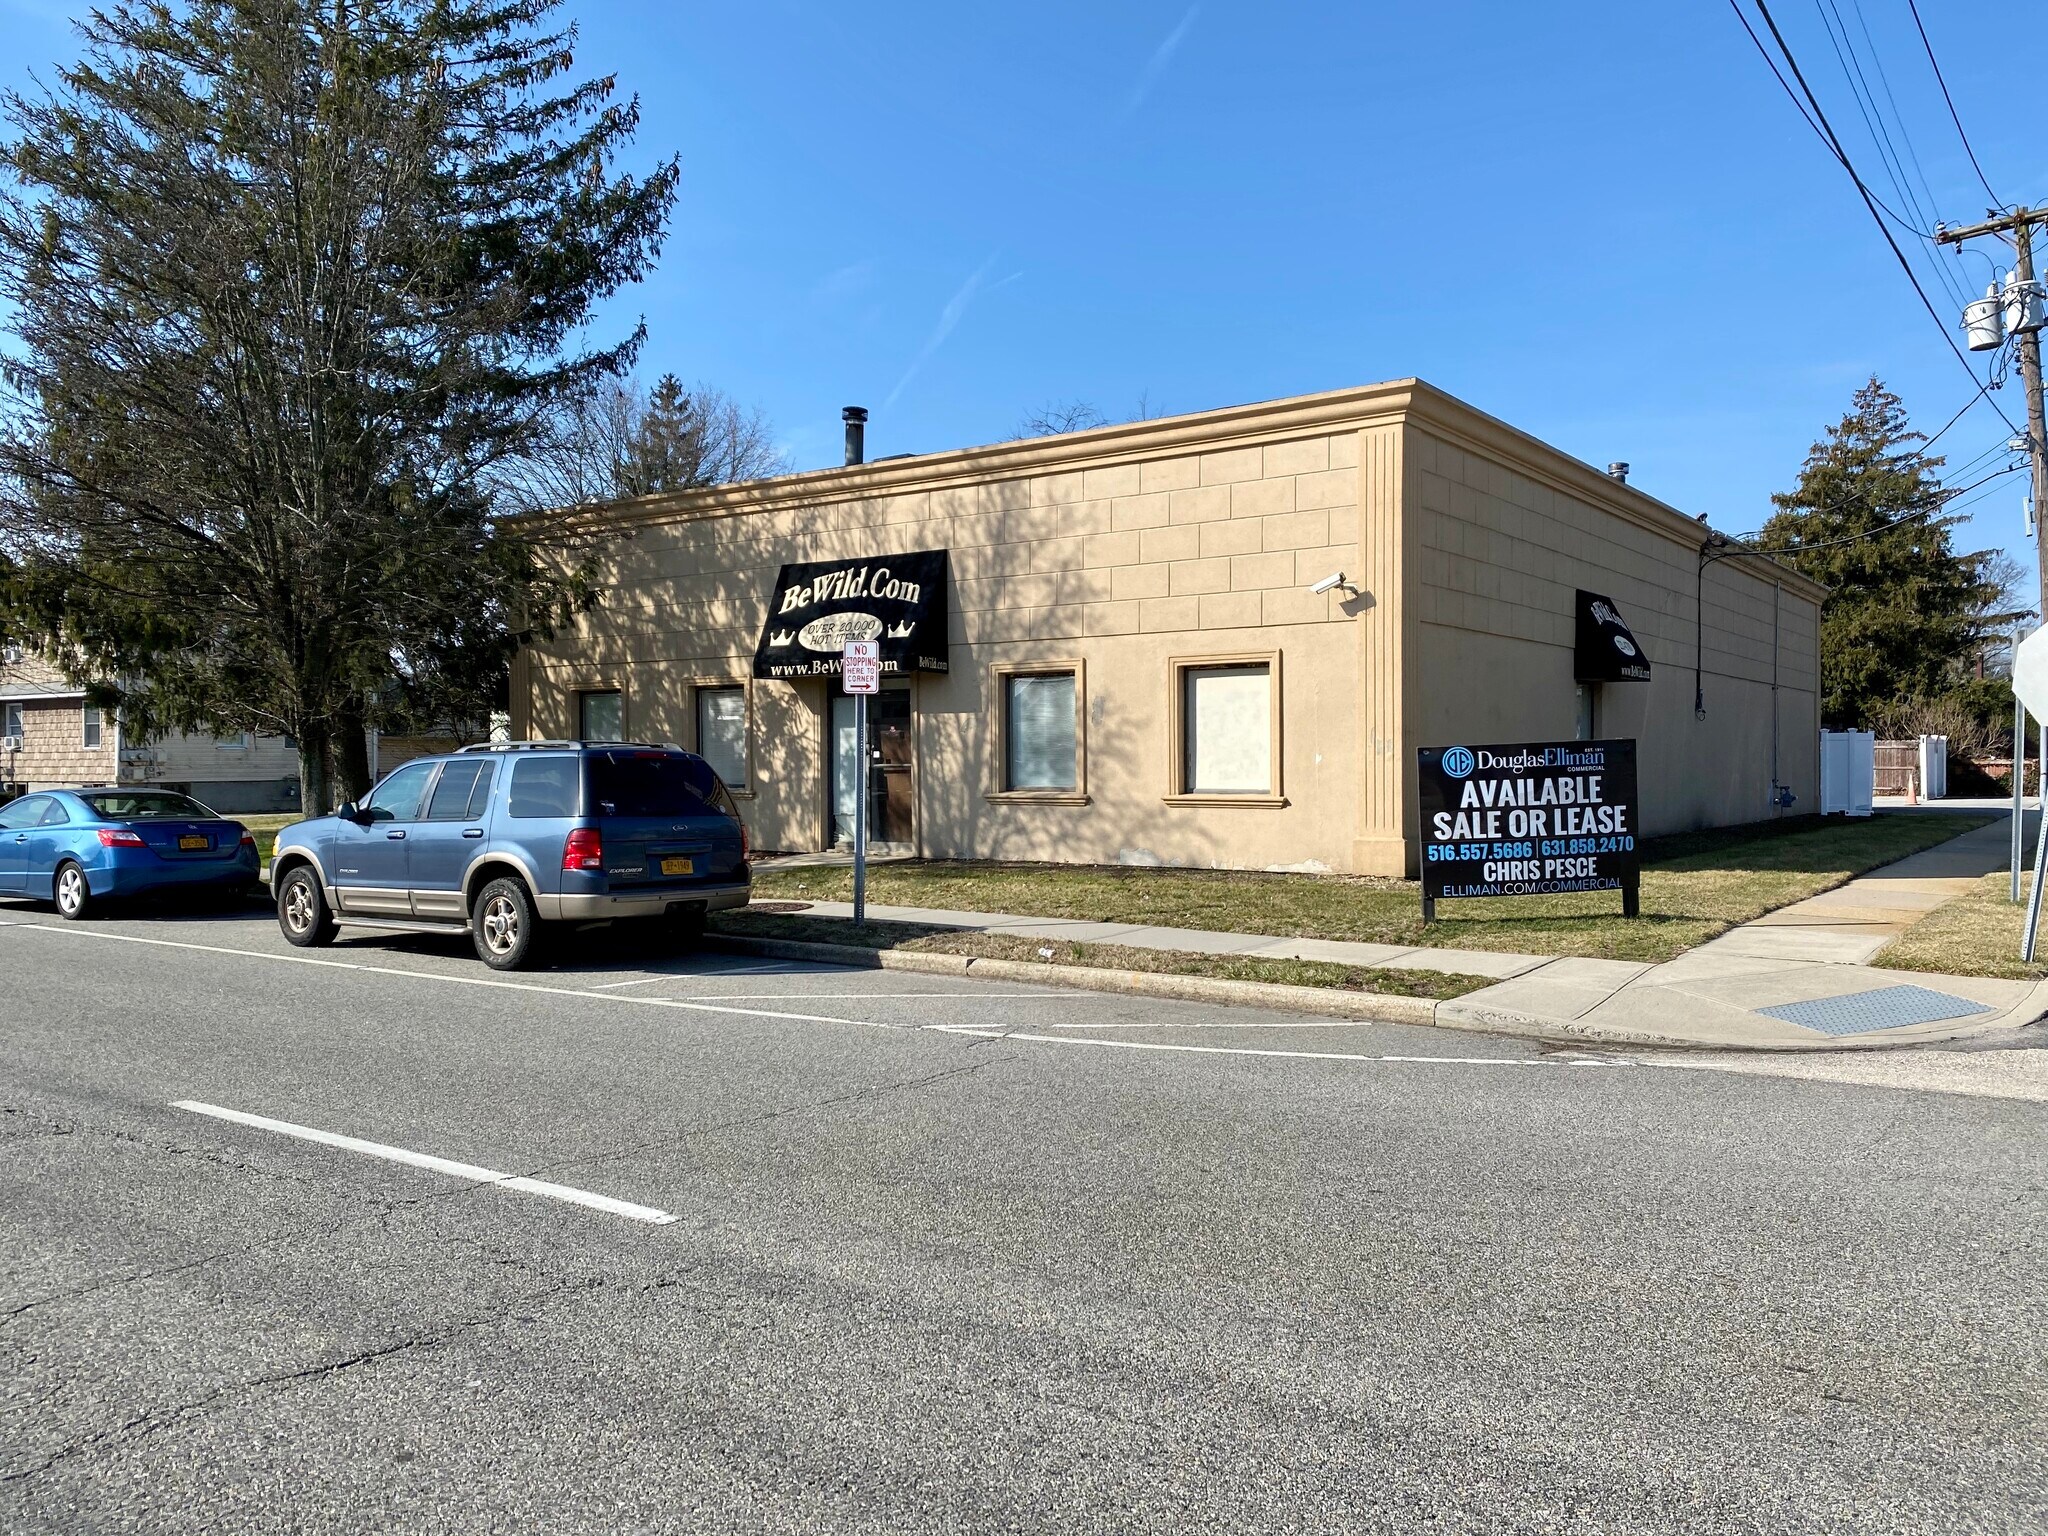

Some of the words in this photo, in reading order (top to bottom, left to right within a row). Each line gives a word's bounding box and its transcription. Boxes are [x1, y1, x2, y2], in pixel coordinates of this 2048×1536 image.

[778, 566, 921, 614] BeWild.Com
[807, 622, 836, 635] OVER
[809, 634, 832, 646] HOT
[854, 645, 868, 656] NO
[846, 657, 876, 667] STOPPING
[847, 675, 875, 683] CORNER
[1460, 776, 1603, 809] AVAILABLE
[1433, 810, 1502, 840] SALE
[1508, 809, 1547, 838] OR
[1554, 805, 1628, 836] LEASE
[1428, 842, 1533, 861] 516.557.5686
[1541, 835, 1634, 856] 631.858.2470
[1483, 860, 1541, 882] CHRIS
[1545, 857, 1598, 879] PESCE
[1443, 878, 1623, 897] ELLIMAN.COM/COMMERCIAL
